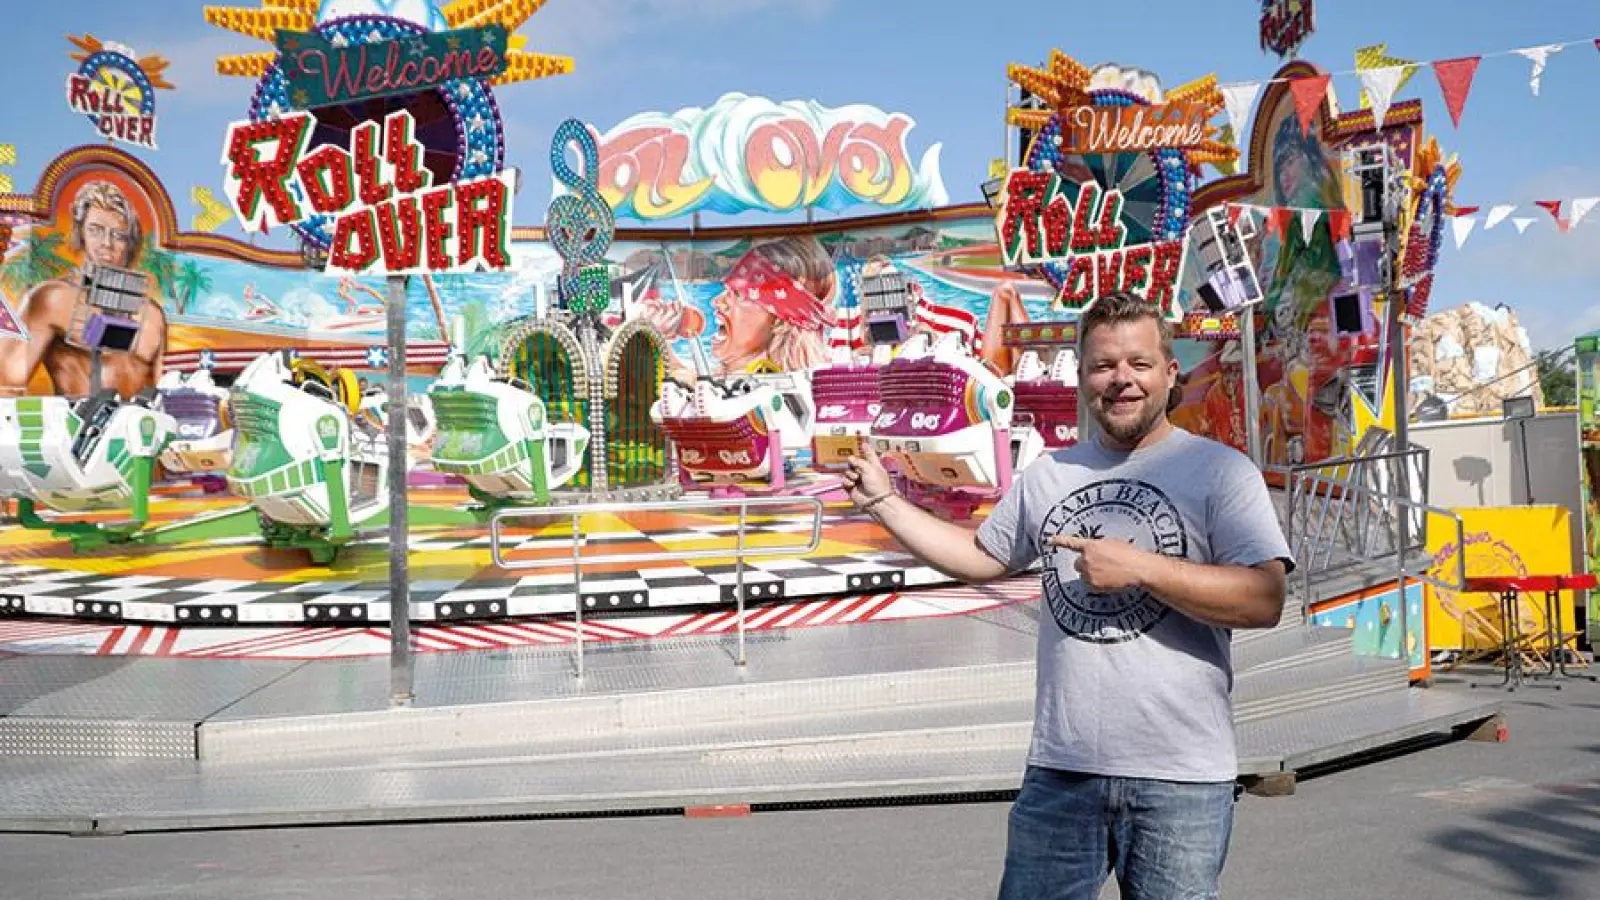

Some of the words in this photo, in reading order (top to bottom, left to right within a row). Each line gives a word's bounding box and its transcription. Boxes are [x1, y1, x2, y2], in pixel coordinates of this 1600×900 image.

[69, 76, 124, 112] ROLL
[300, 41, 498, 98] Welcome
[101, 114, 154, 147] OVER
[1075, 106, 1203, 150] Welcome
[227, 113, 433, 224] ROLL
[330, 178, 511, 272] OVER
[1001, 170, 1124, 260] ROLL
[1061, 240, 1182, 320] OVER
[1114, 485, 1180, 549] BEACH
[1044, 572, 1112, 638] AUTHENTIC
